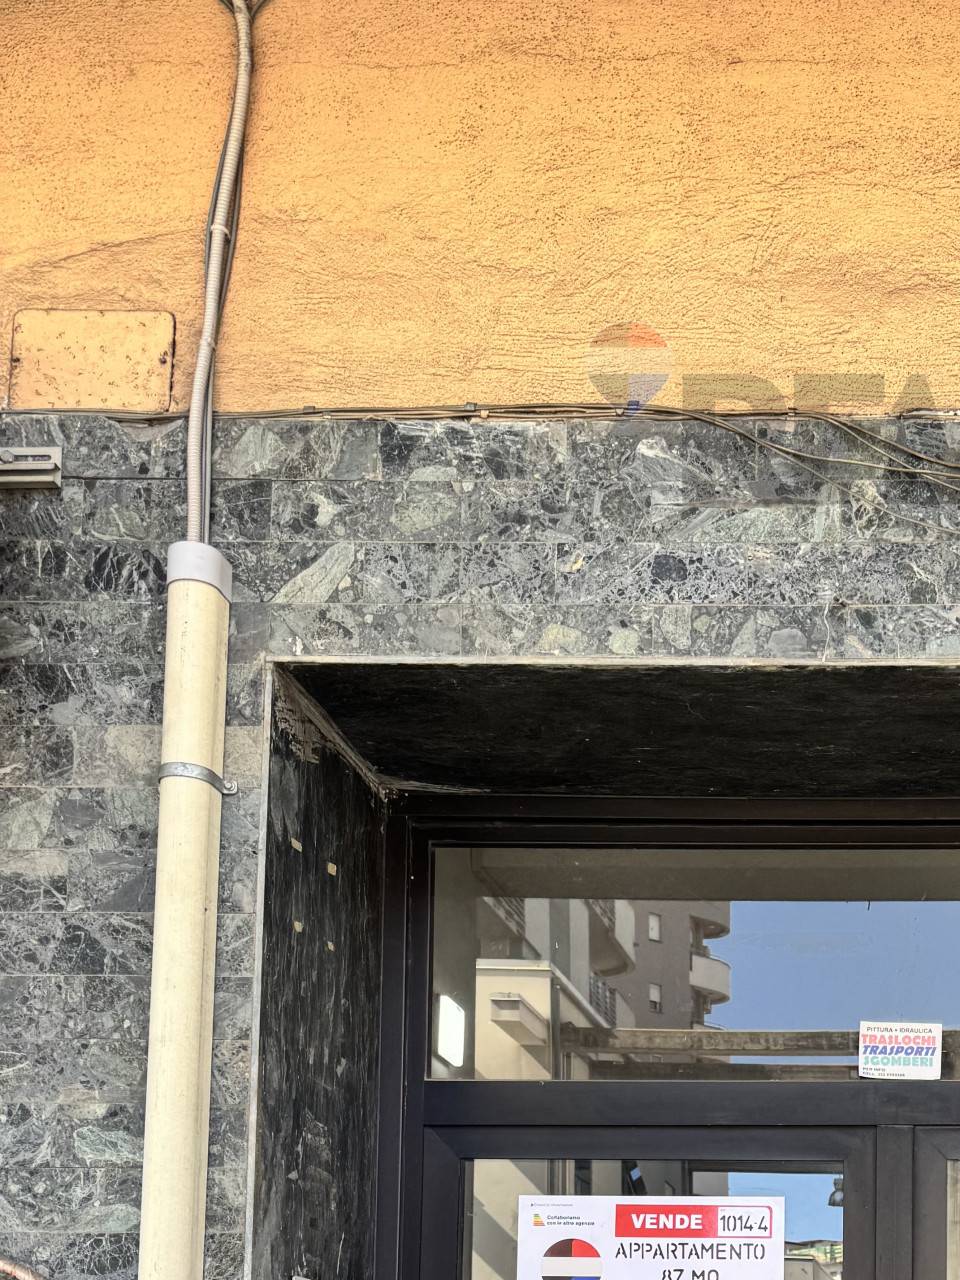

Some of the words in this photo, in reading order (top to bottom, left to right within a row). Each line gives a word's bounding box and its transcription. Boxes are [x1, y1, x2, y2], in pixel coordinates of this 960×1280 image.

[861, 1034, 936, 1046] TRASLOCHI
[862, 1045, 937, 1056] TRASPORTI
[863, 1056, 933, 1067] SGOMBERI
[631, 1213, 703, 1230] VENDE
[615, 1242, 766, 1260] APPARTAMENTO
